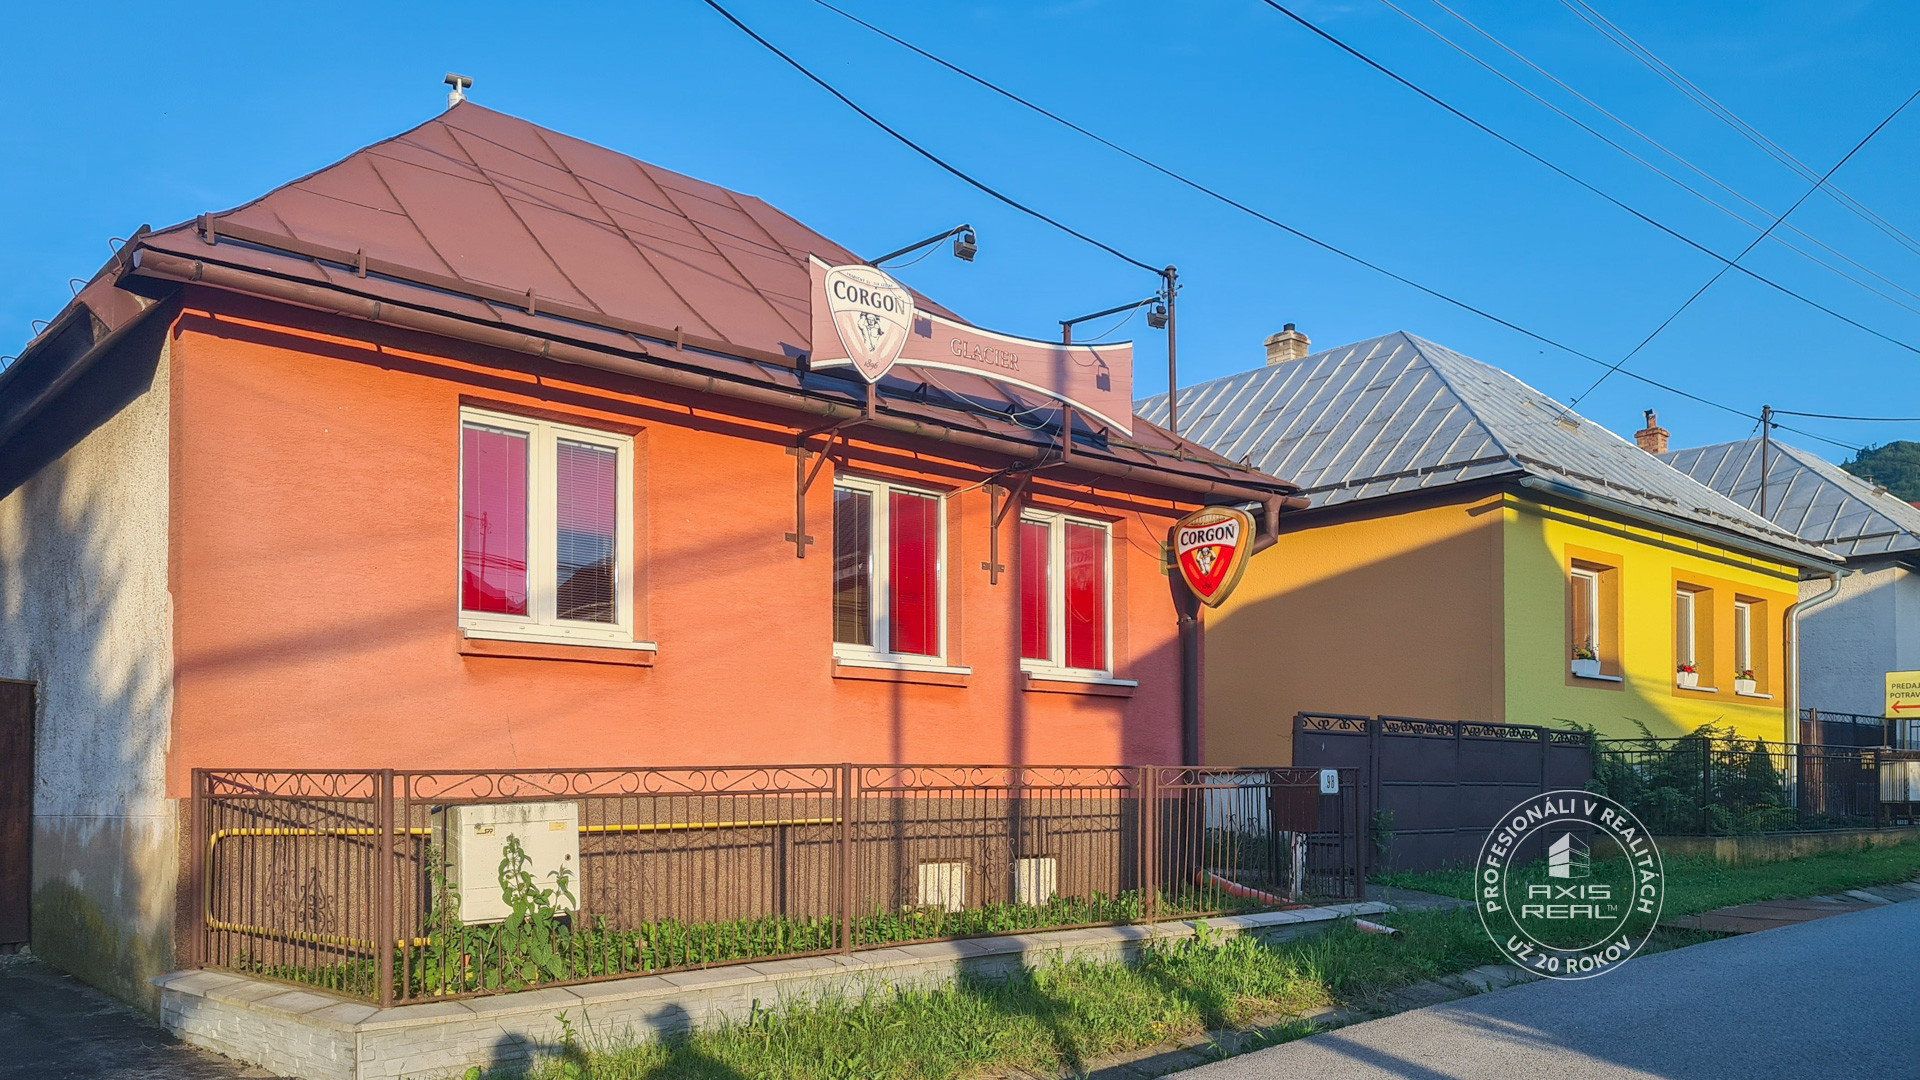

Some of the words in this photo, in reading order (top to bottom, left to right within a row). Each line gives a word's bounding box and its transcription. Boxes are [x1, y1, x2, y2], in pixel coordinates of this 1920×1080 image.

[833, 280, 905, 315] CORGOŇ
[950, 338, 1020, 371] GLACIER
[1180, 523, 1235, 546] CORGOŇ
[1326, 774, 1335, 789] 98
